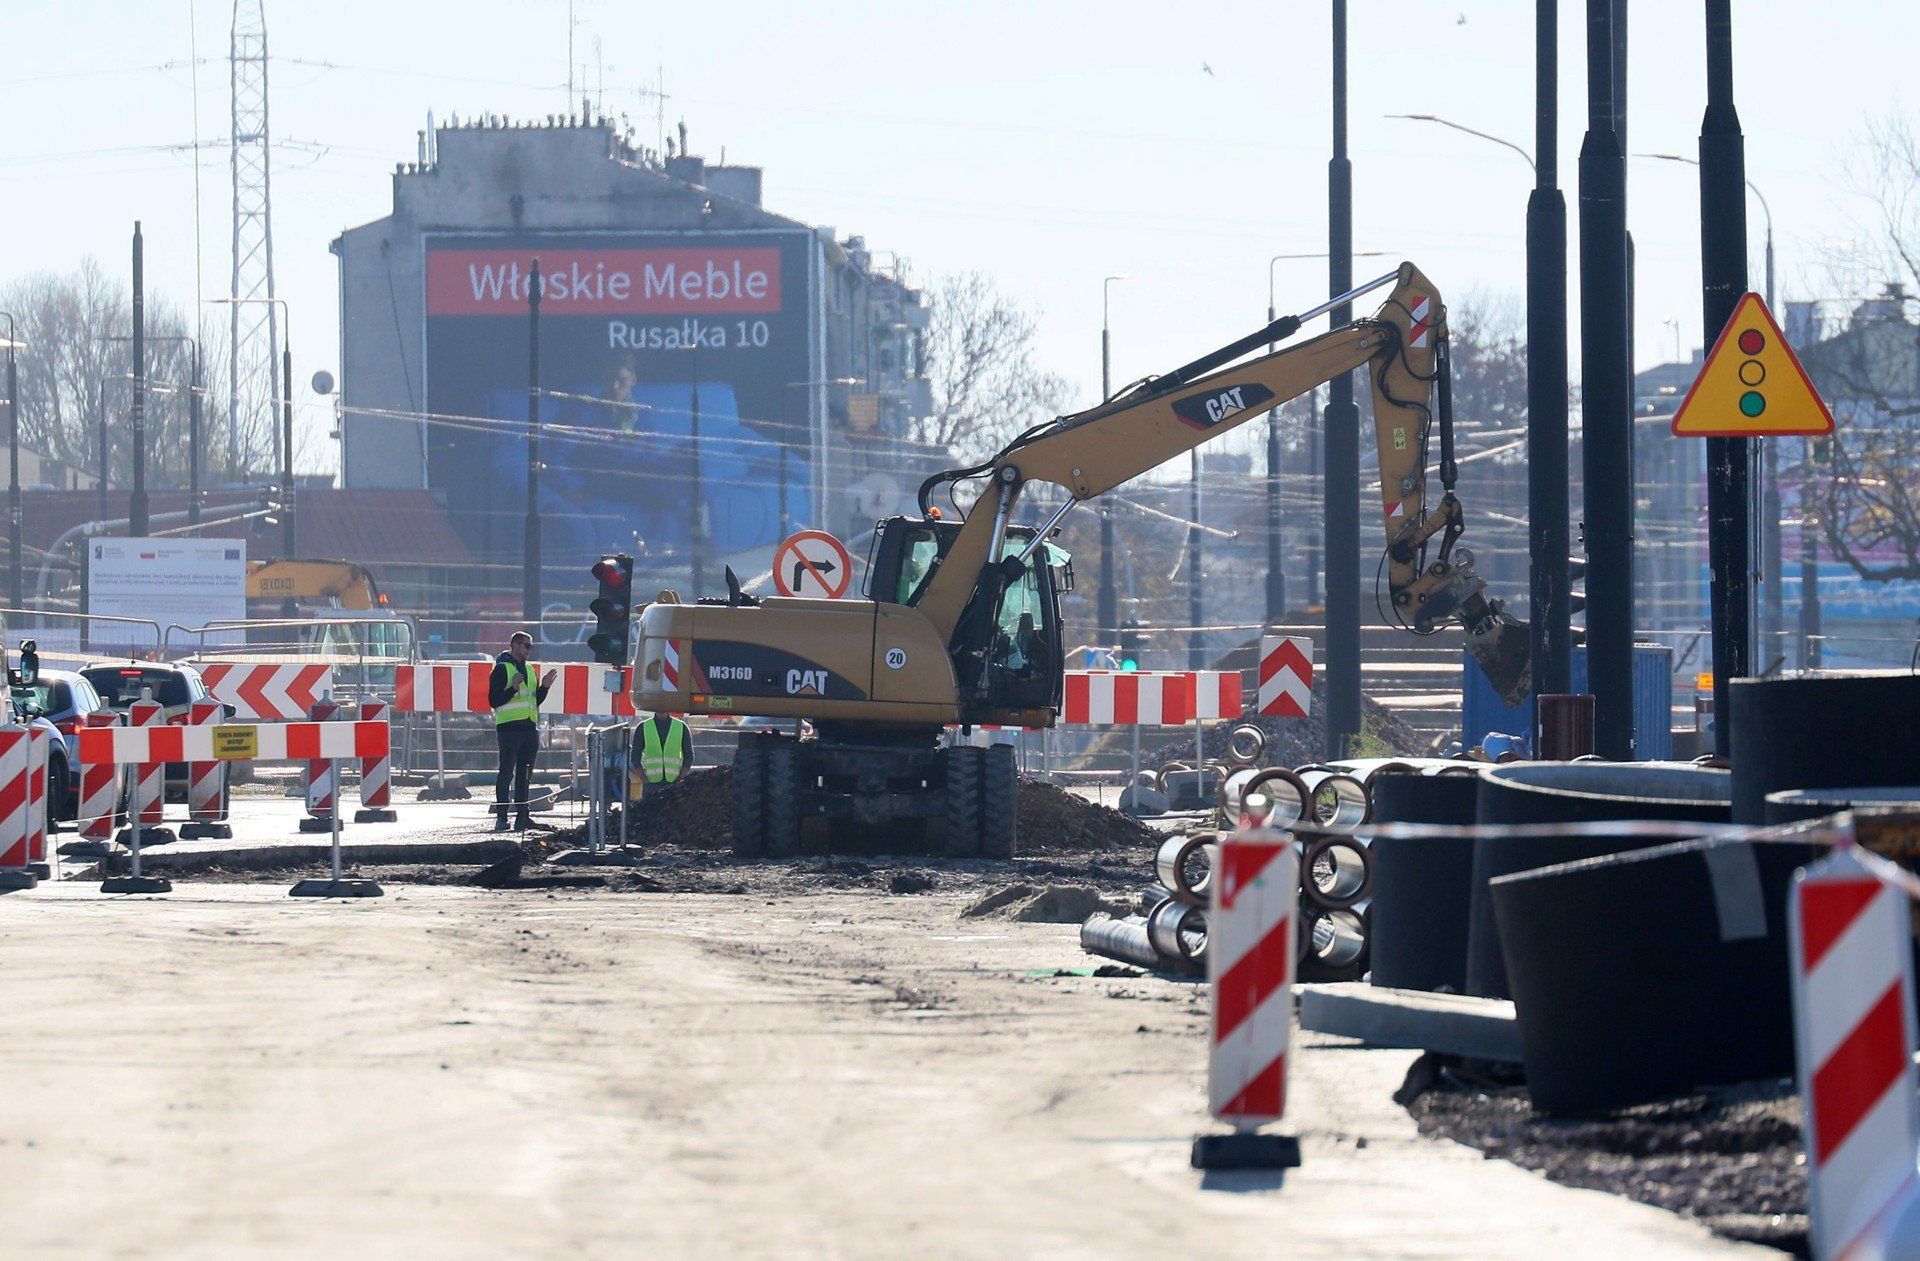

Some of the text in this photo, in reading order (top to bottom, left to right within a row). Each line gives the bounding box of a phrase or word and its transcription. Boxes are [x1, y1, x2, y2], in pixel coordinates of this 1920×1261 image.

[469, 259, 769, 300] Włoskie Meble
[608, 318, 770, 349] Rusałka 10
[1205, 386, 1246, 423] CAT
[889, 652, 903, 665] 20
[709, 665, 828, 695] M316D CAT
